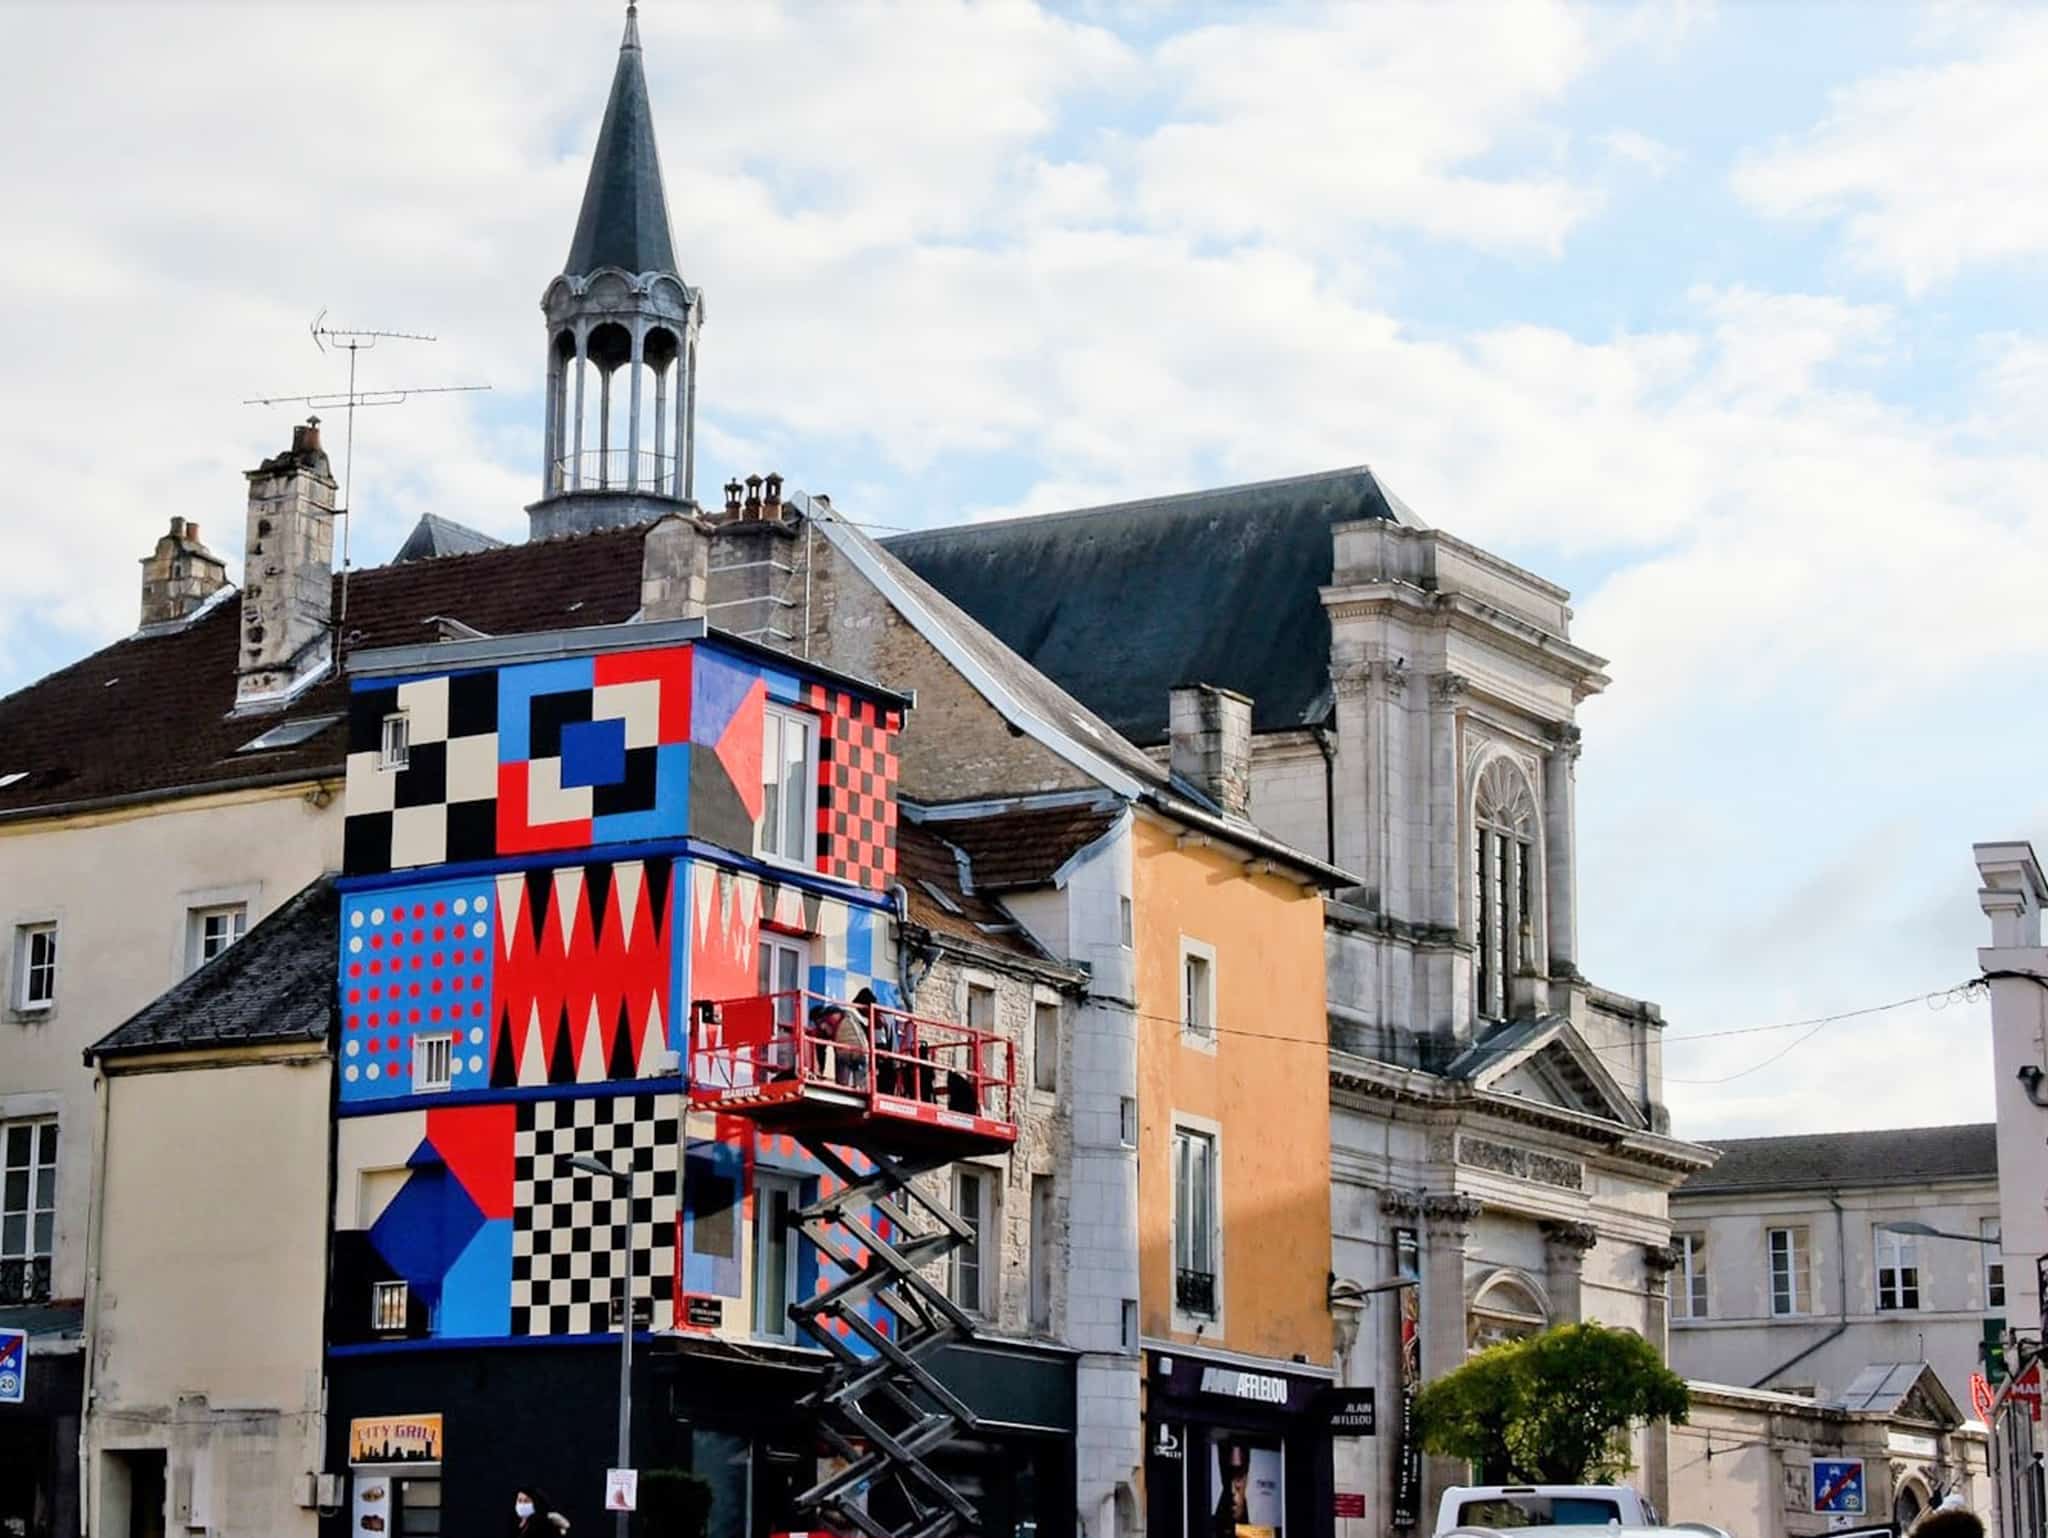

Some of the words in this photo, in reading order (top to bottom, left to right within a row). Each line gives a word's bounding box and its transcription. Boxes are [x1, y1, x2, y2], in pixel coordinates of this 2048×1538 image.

[1, 1378, 14, 1389] 20
[1236, 1372, 1288, 1404] AFFLELOU
[1345, 1403, 1373, 1414] ALAIN
[357, 1423, 391, 1441] CITY
[395, 1423, 436, 1441] GRILL
